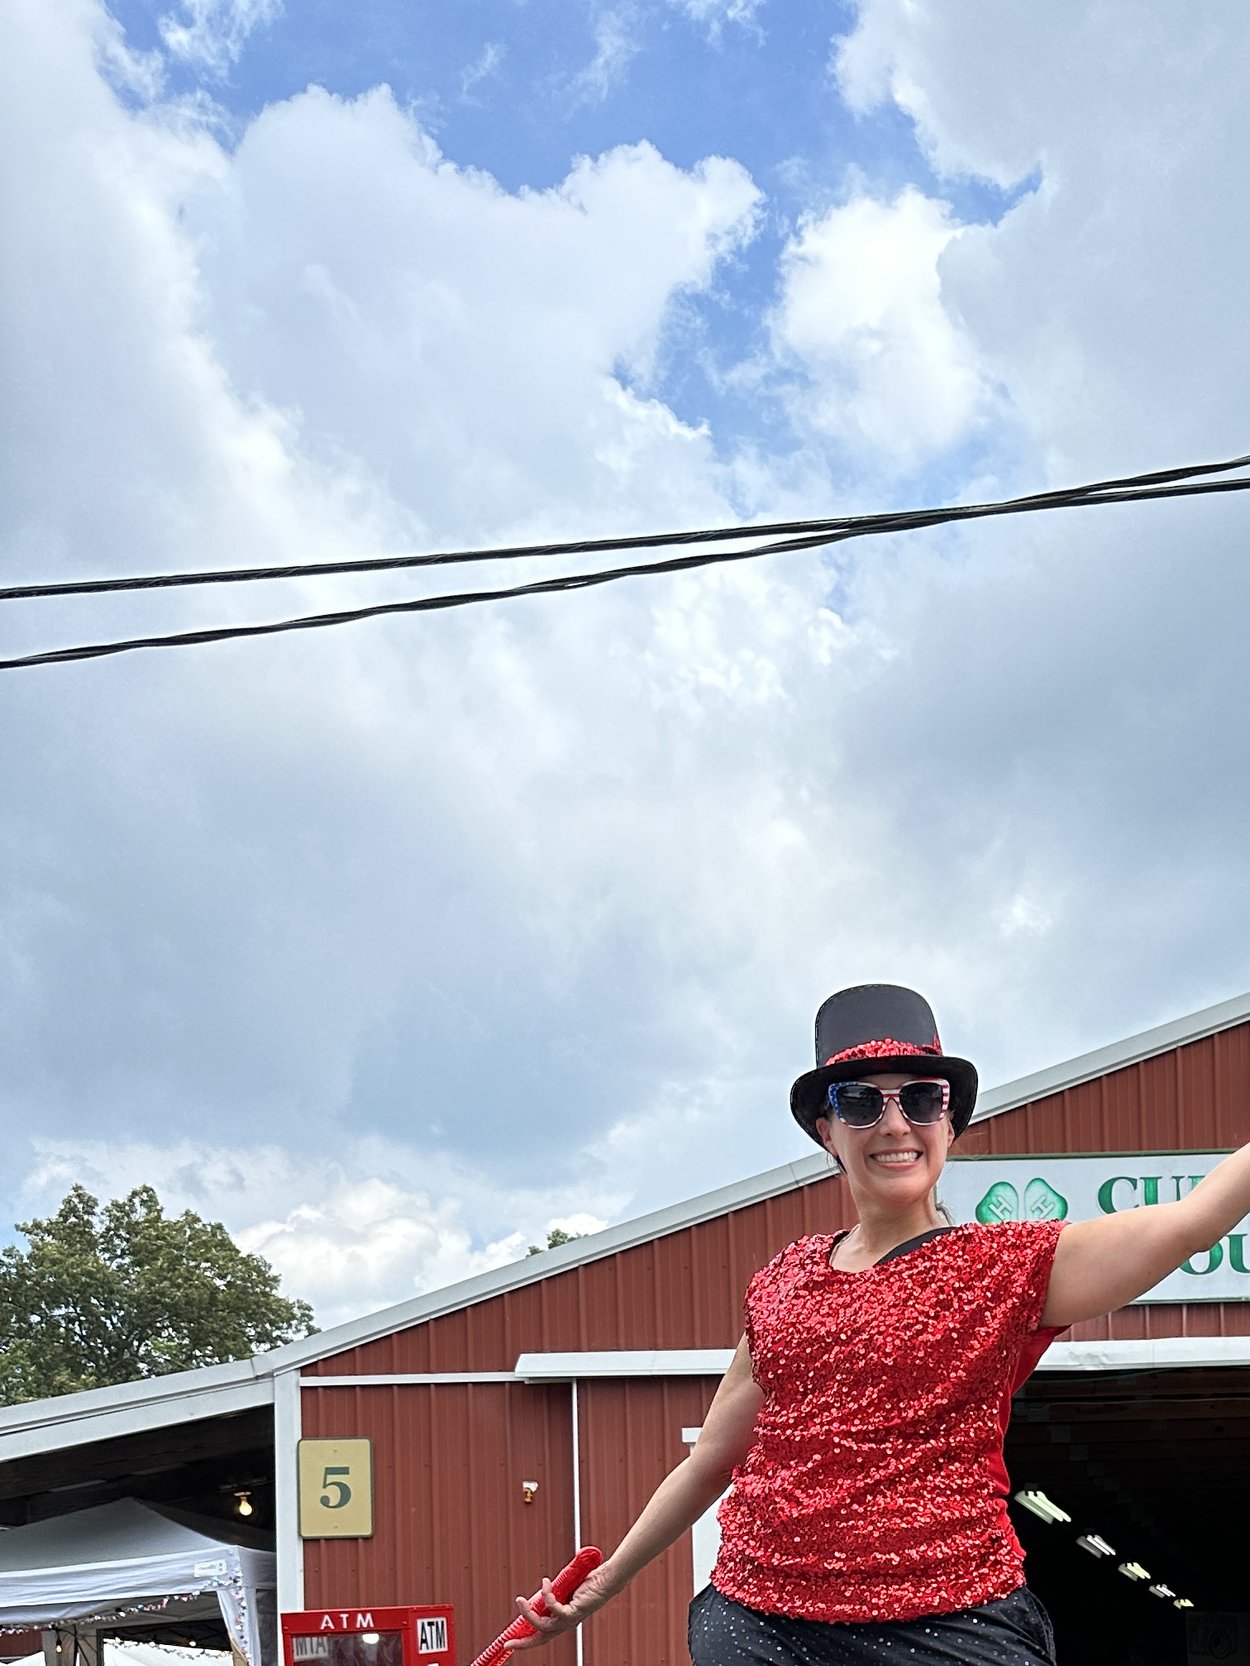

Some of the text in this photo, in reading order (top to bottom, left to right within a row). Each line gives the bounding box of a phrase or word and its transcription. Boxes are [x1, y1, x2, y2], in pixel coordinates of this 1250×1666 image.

[320, 1466, 352, 1509] 5
[320, 1612, 374, 1630] ATM
[419, 1620, 446, 1650] ATM
